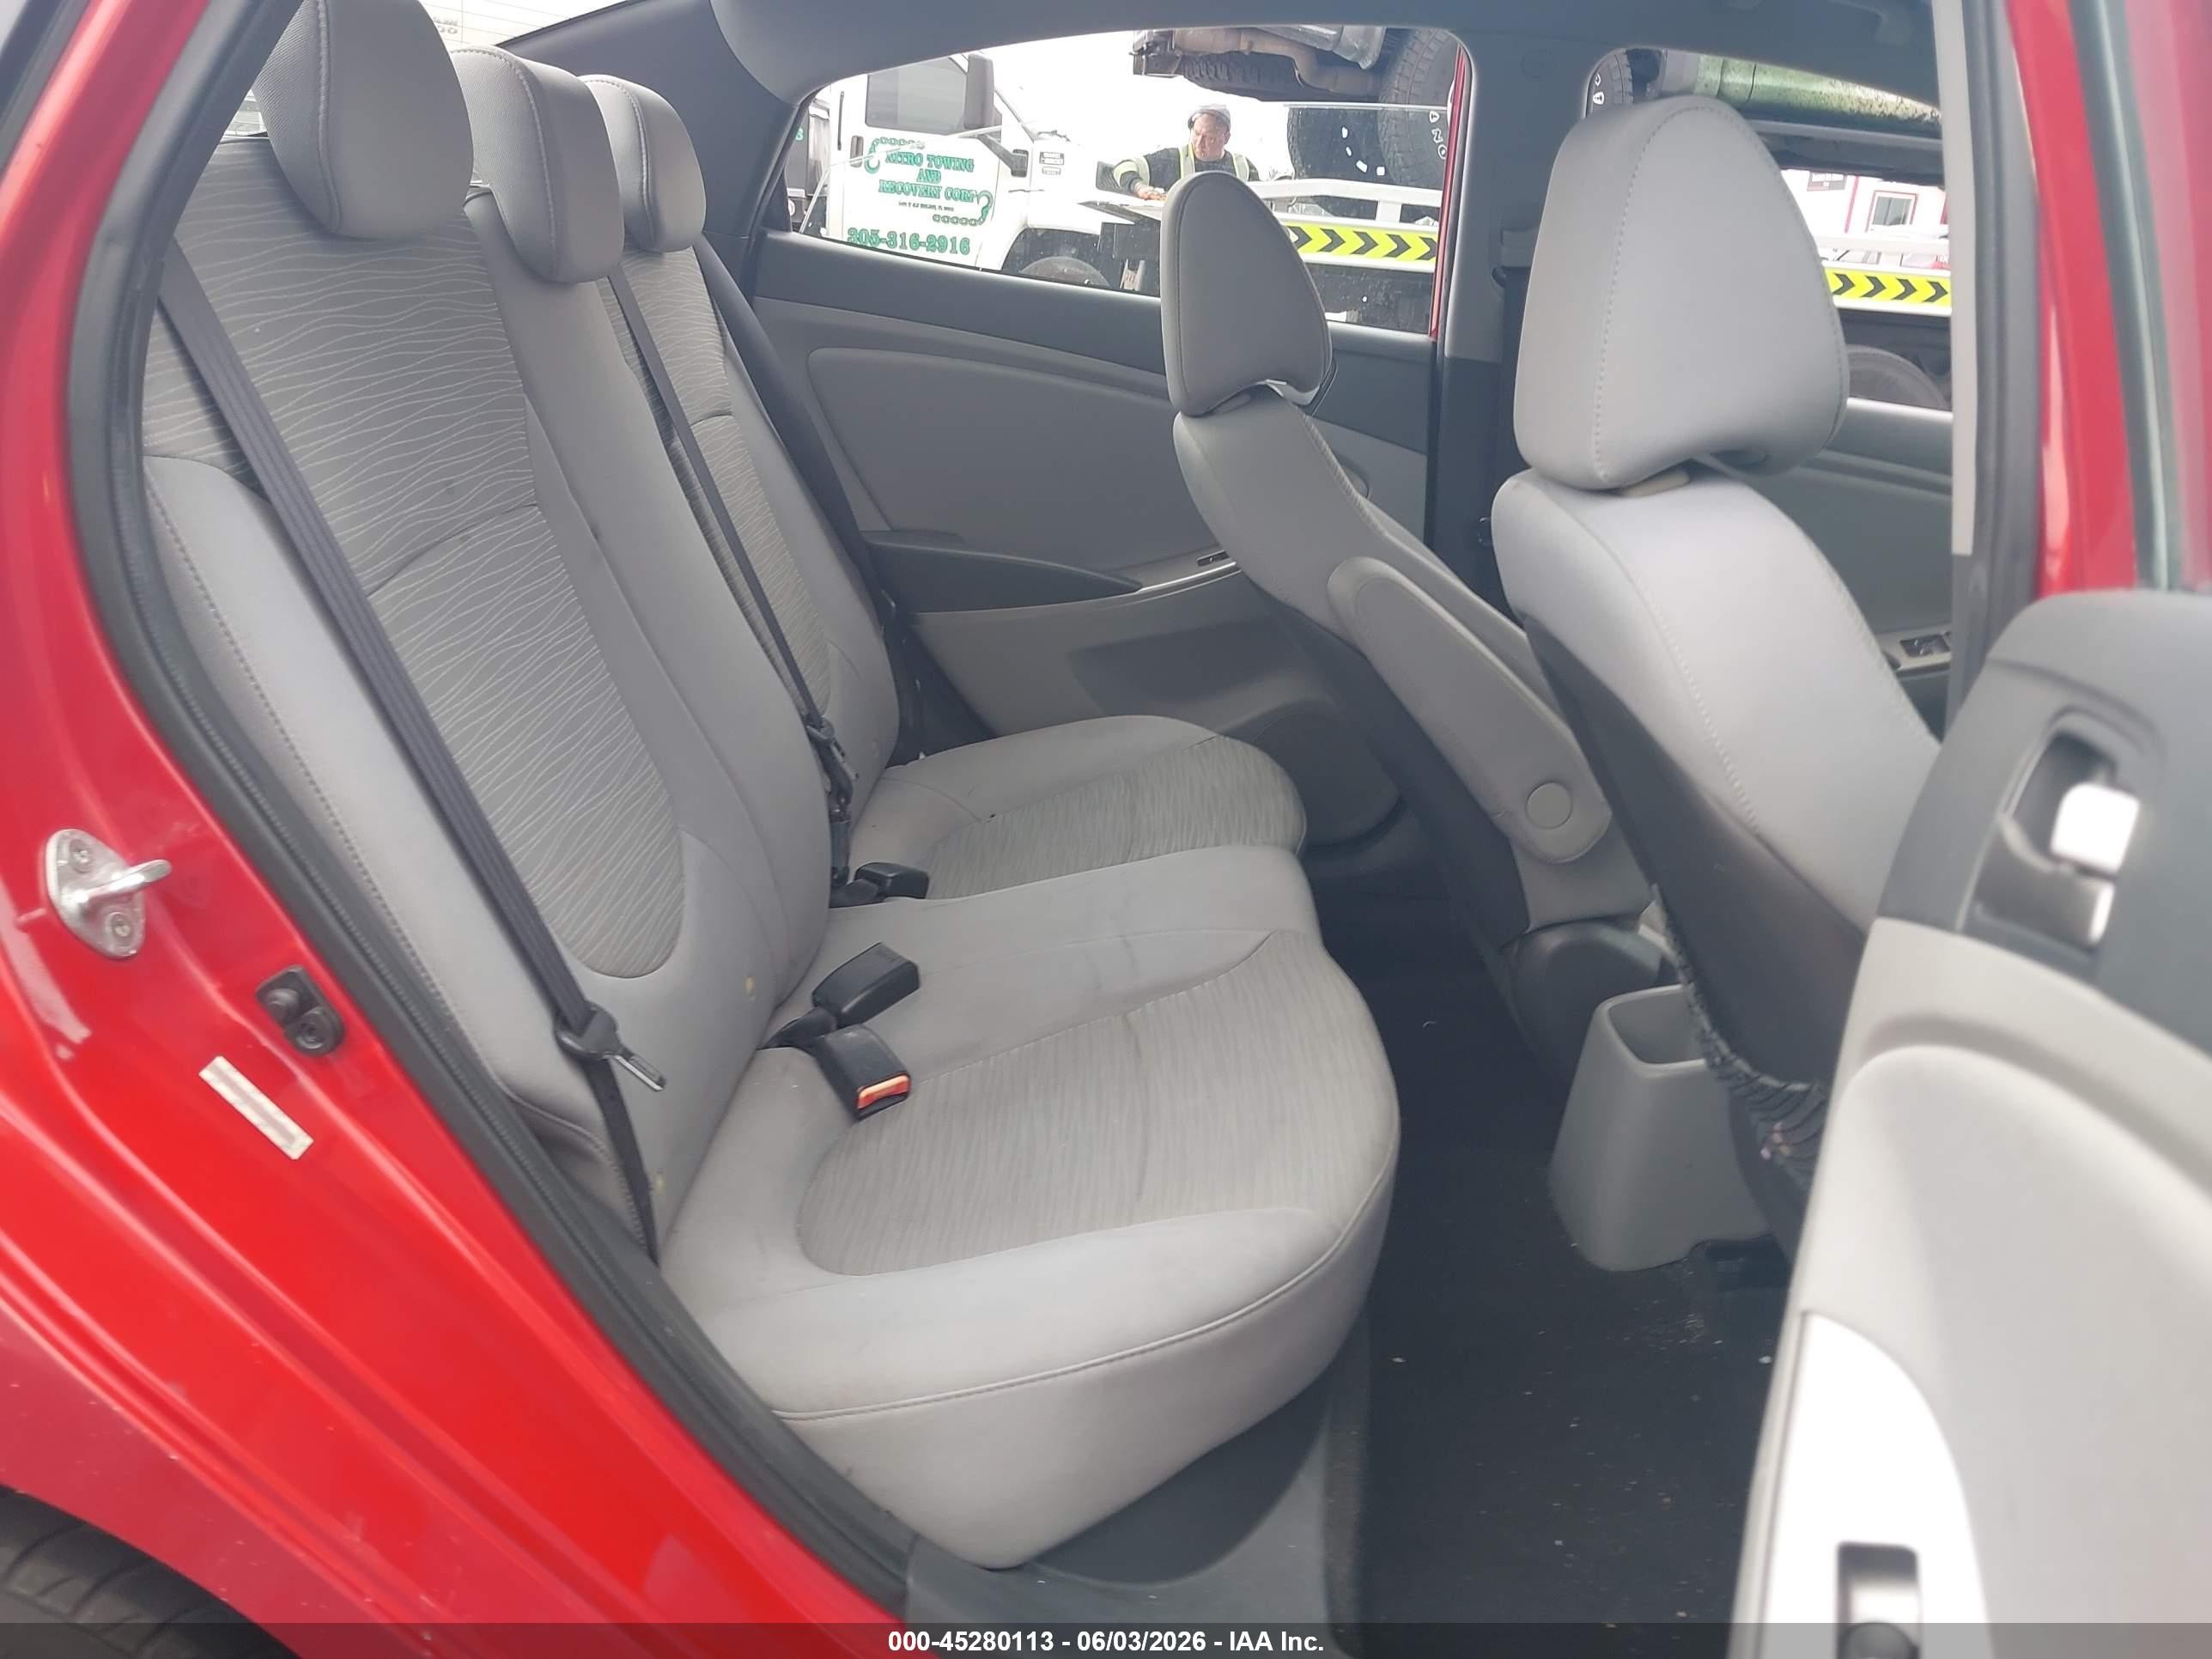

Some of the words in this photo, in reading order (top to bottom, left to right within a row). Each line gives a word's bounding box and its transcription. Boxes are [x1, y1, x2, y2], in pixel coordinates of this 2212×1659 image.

[927, 154, 975, 173] TOWING
[916, 168, 942, 184] AND
[878, 179, 942, 199] RECOVERY
[847, 227, 970, 255] 305-316-2916
